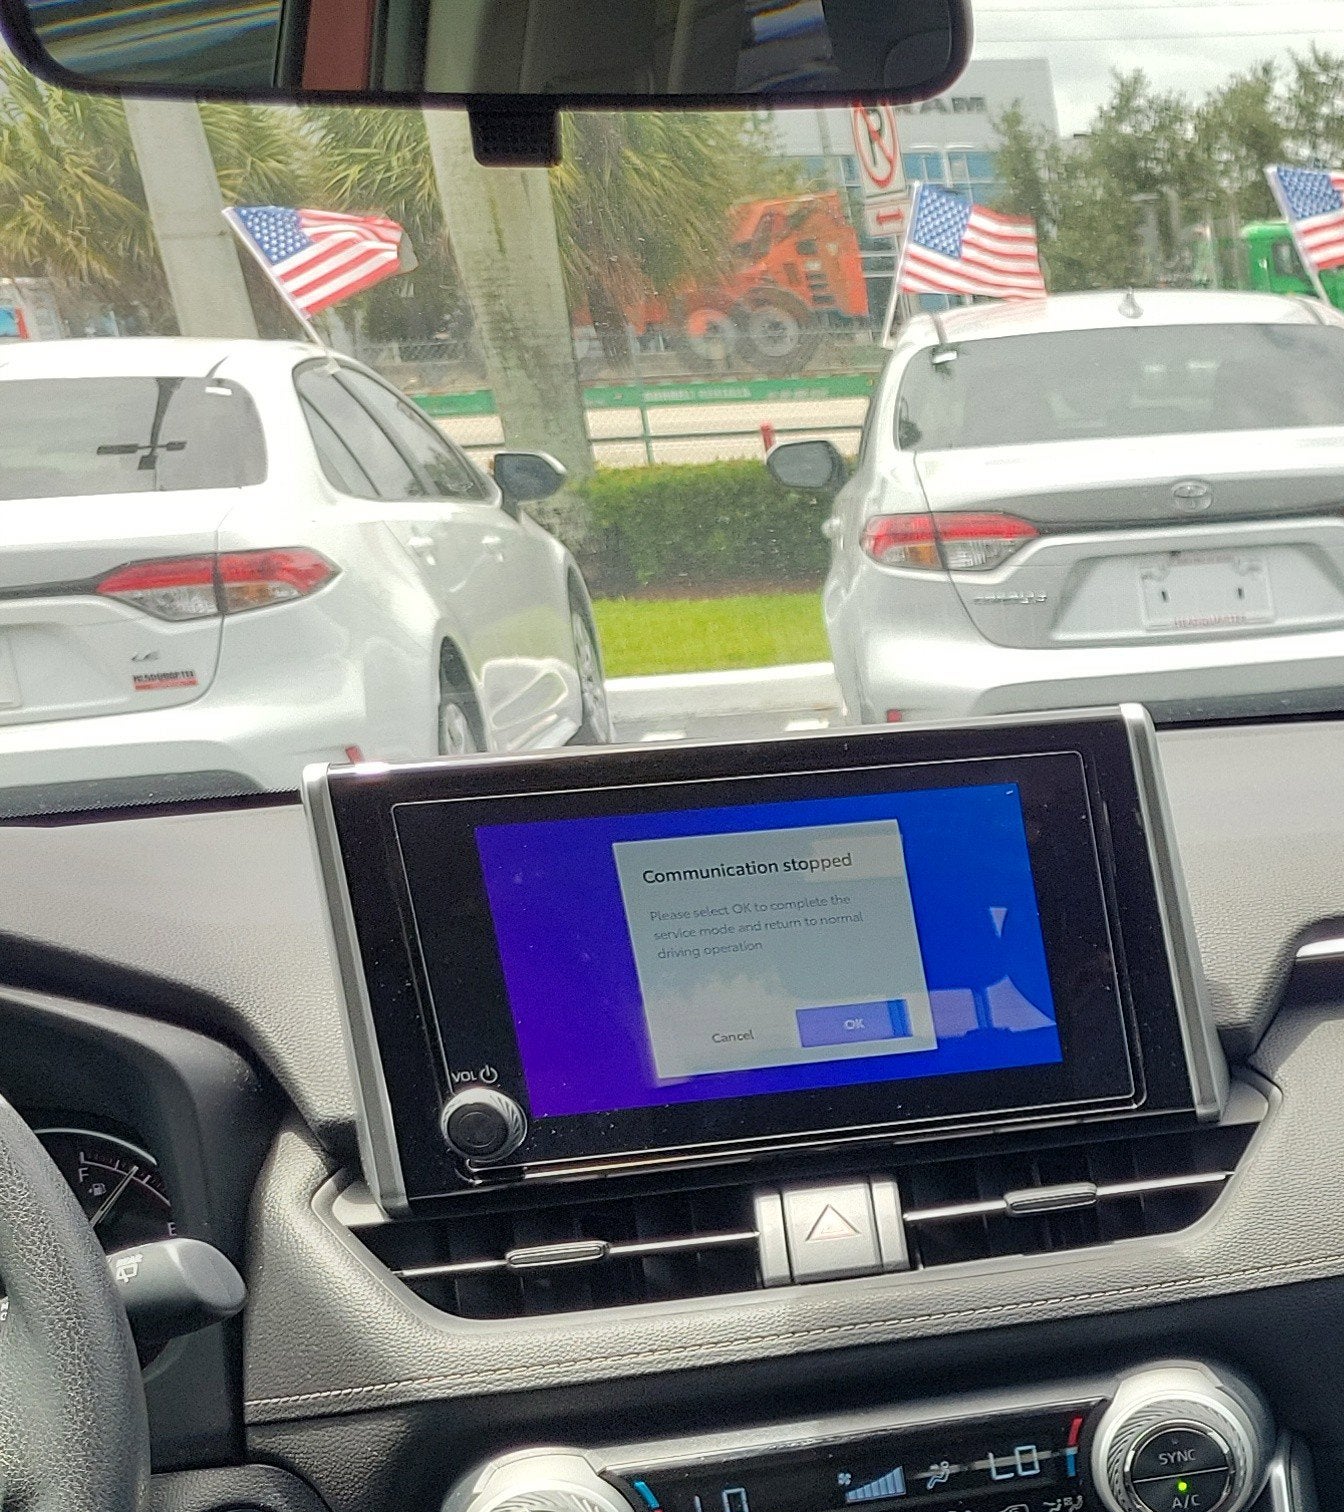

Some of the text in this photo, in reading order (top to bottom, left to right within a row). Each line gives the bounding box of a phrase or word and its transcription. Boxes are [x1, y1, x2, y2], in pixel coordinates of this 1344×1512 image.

[642, 853, 853, 884] Communication stopped
[650, 894, 852, 921] Please select OK to complete the
[653, 911, 864, 941] service mode and return to normal
[657, 941, 763, 960] driving operation
[843, 1018, 866, 1031] OK
[711, 1029, 755, 1045] Cancel
[452, 1071, 477, 1083] VOL
[78, 1167, 89, 1183] F
[167, 1222, 177, 1236] E
[1158, 1448, 1197, 1467] SYNC
[1171, 1493, 1200, 1510] A/C
